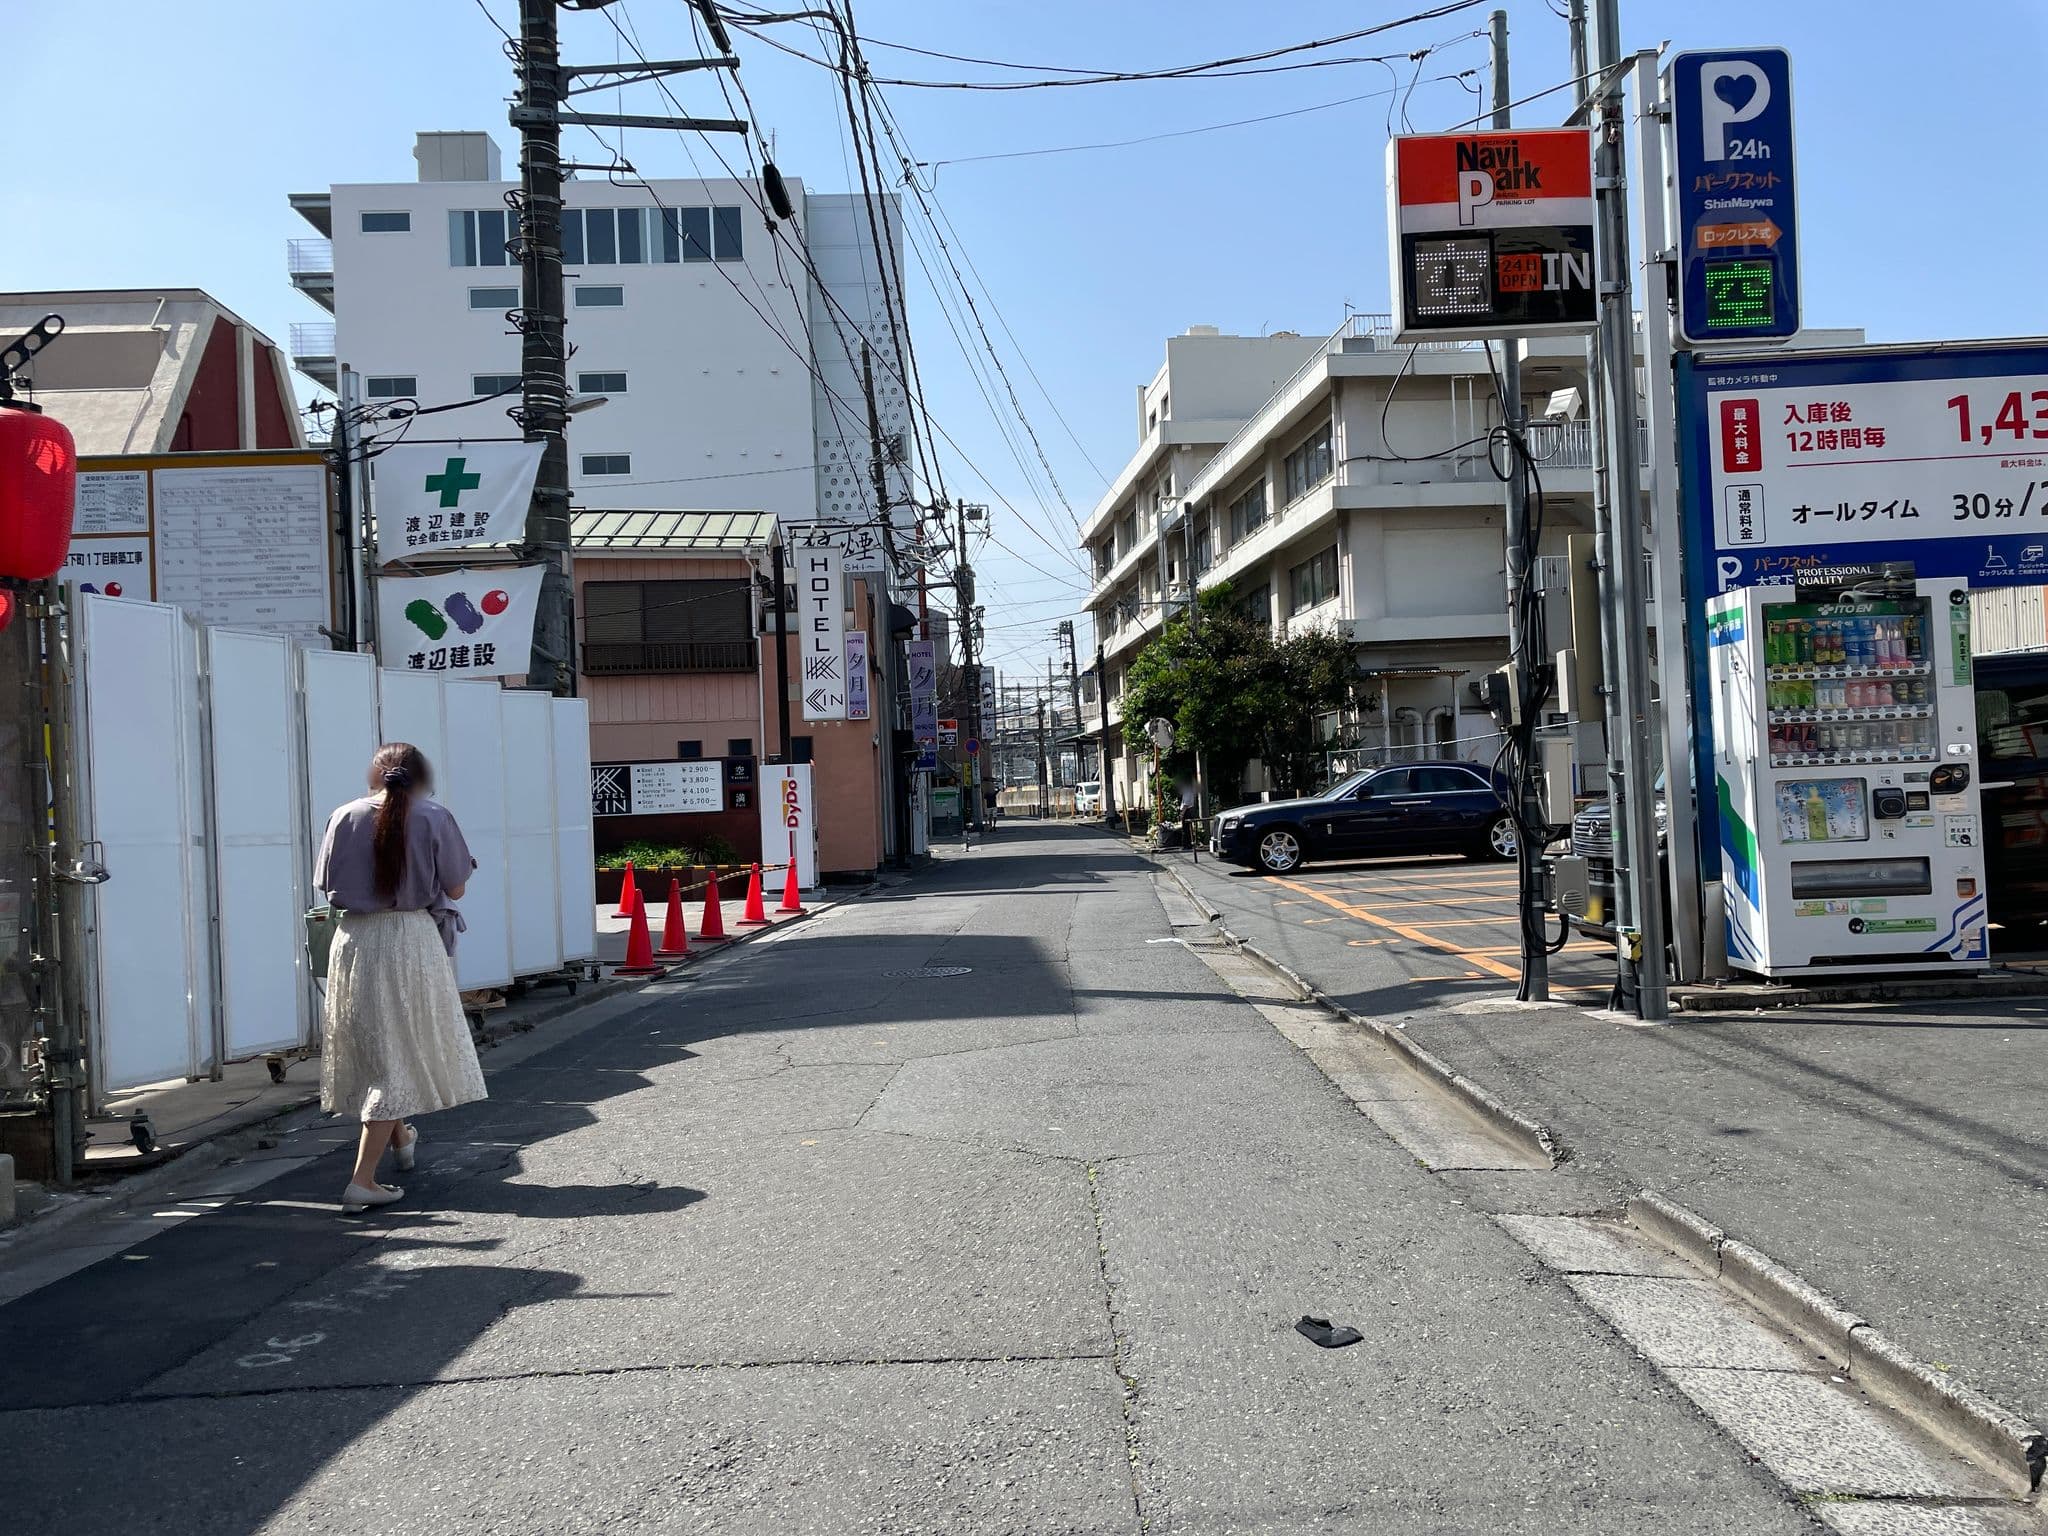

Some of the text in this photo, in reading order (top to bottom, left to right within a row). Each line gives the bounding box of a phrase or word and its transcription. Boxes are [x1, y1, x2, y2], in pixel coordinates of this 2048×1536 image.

[1456, 139, 1519, 170] Navi
[1729, 139, 1770, 160] 24h
[1459, 161, 1542, 226] Park
[1692, 171, 1781, 192] パークネット
[1704, 197, 1773, 210] ShinMaywa
[1704, 228, 1772, 242] ロックレス式
[1416, 243, 1489, 315] 空
[1503, 274, 1537, 287] OPEN
[1543, 253, 1591, 291] IN
[1706, 263, 1772, 326] 空
[1707, 374, 1778, 386] 監視カメラ作動中
[1783, 402, 1852, 425] 入庫後
[1733, 408, 1749, 464] 最大料金
[1786, 427, 1886, 452] 12時間毎
[405, 511, 490, 533] 渡辺建設
[1738, 489, 1753, 540] 通常料金
[1792, 499, 1920, 524] オールタイム
[1754, 554, 1821, 571] パークネット
[1796, 565, 1873, 576] PROFESSIONAL
[1798, 575, 1844, 586] QUALITY
[811, 557, 830, 652] HOTEL
[1834, 604, 1873, 614] ITO EN
[408, 643, 496, 671] 渡辺建設
[849, 653, 865, 693] 夕月
[786, 779, 802, 828] DyDo
